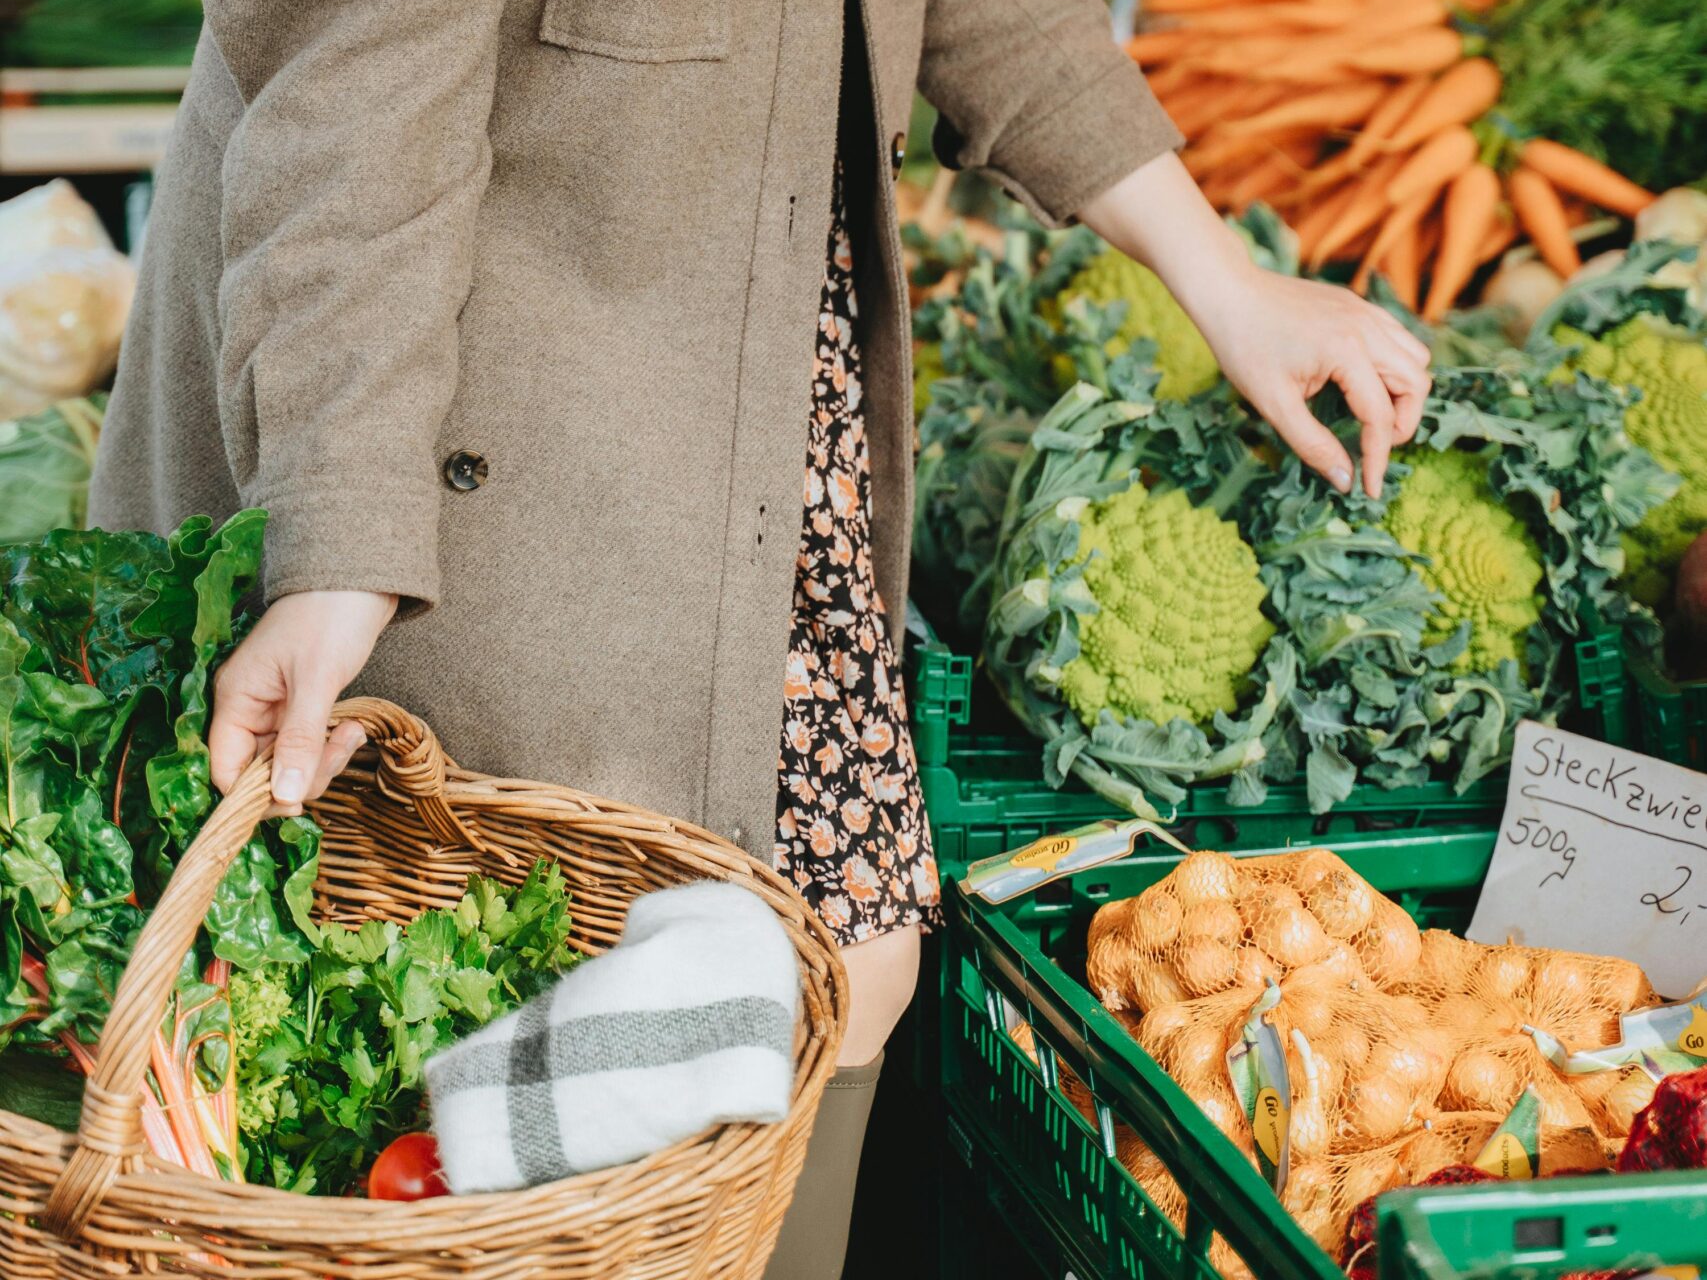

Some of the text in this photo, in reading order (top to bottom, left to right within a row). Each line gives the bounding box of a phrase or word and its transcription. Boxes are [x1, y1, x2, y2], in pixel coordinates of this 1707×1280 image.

[1506, 817, 1577, 888] 500g
[1686, 1033, 1704, 1049] Go
[1264, 1095, 1279, 1117] Go
